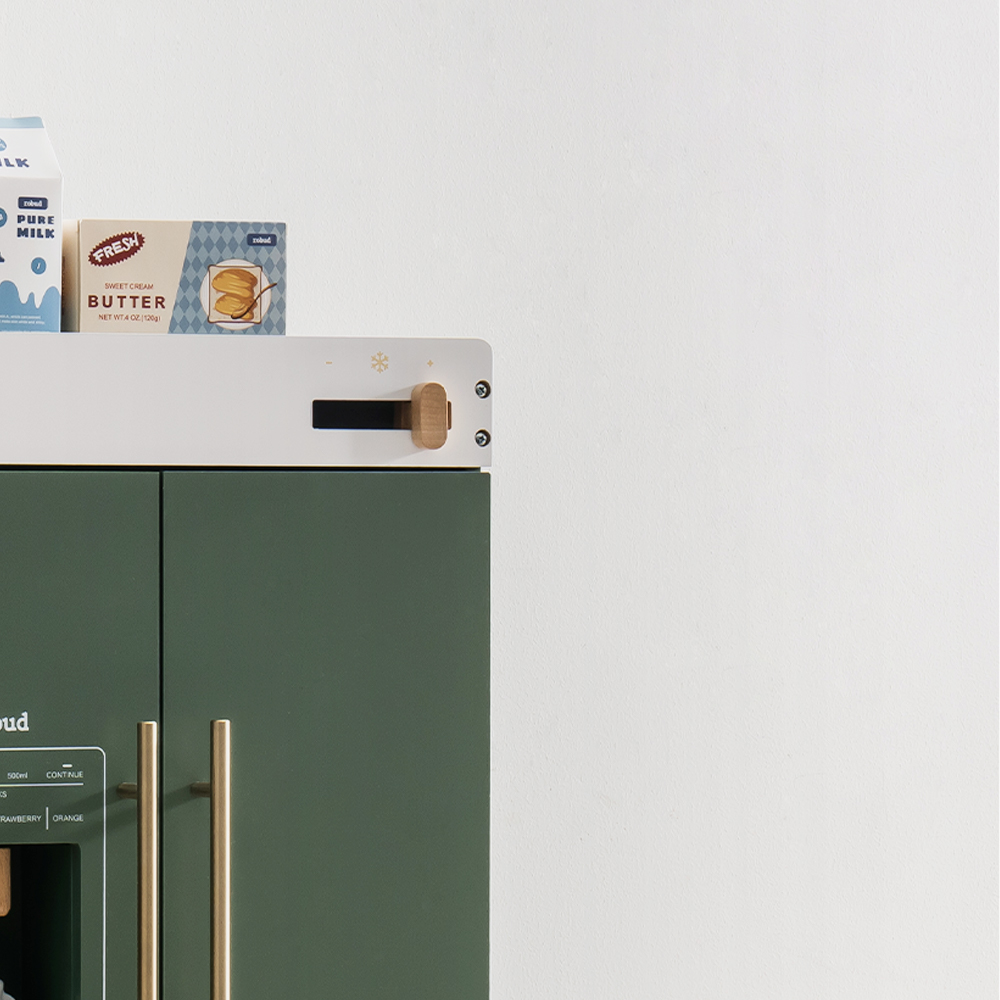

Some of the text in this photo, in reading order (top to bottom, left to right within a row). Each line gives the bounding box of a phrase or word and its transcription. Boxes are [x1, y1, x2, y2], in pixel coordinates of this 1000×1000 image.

[17, 214, 55, 225] PURE
[17, 227, 55, 239] MILK
[92, 232, 140, 263] FRESH
[104, 282, 154, 291] SWEET CREAM
[87, 294, 166, 309] BUTTER
[7, 772, 28, 780] 500ml
[46, 770, 84, 779] CONTINUE
[52, 813, 84, 823] ORANGE
